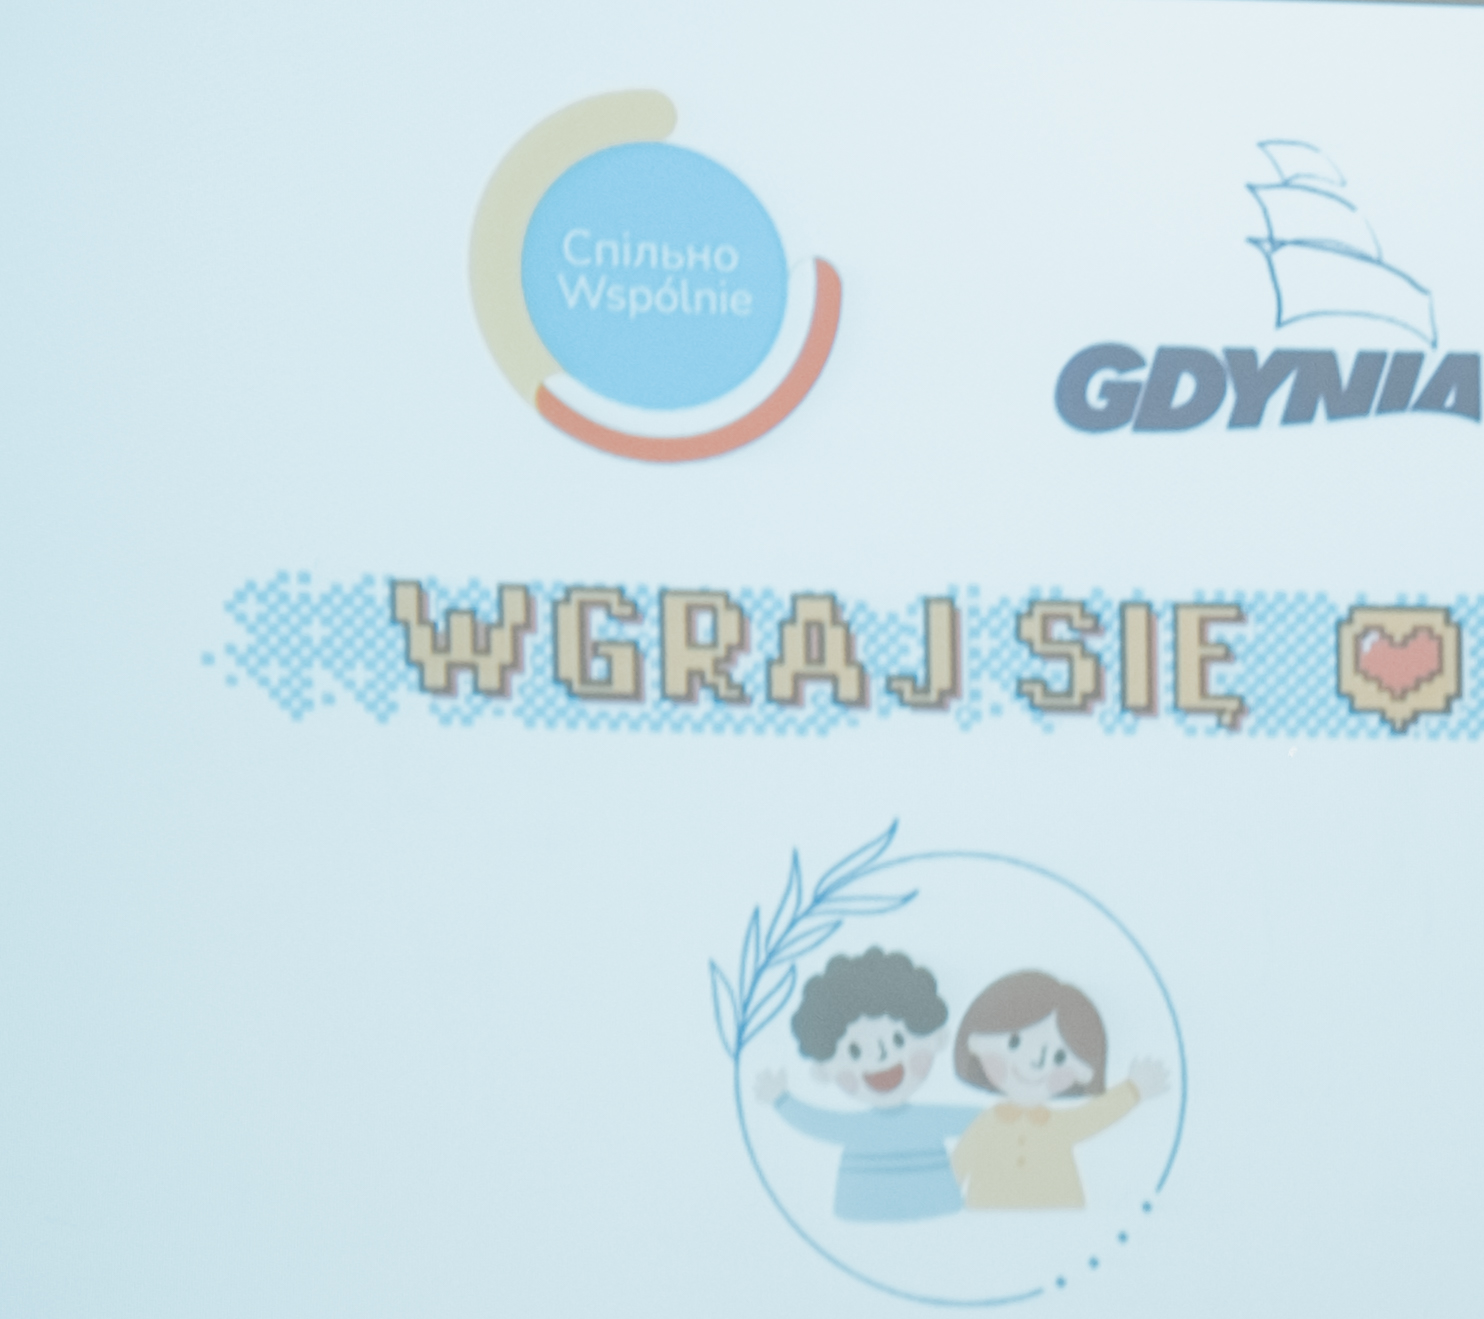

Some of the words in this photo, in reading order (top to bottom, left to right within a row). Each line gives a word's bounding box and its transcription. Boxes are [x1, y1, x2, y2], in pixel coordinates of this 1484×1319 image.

[561, 227, 740, 274] Спільно
[557, 271, 754, 320] Wspólnie
[1053, 341, 1483, 434] GDYNIA
[389, 579, 962, 711] WGRAJ
